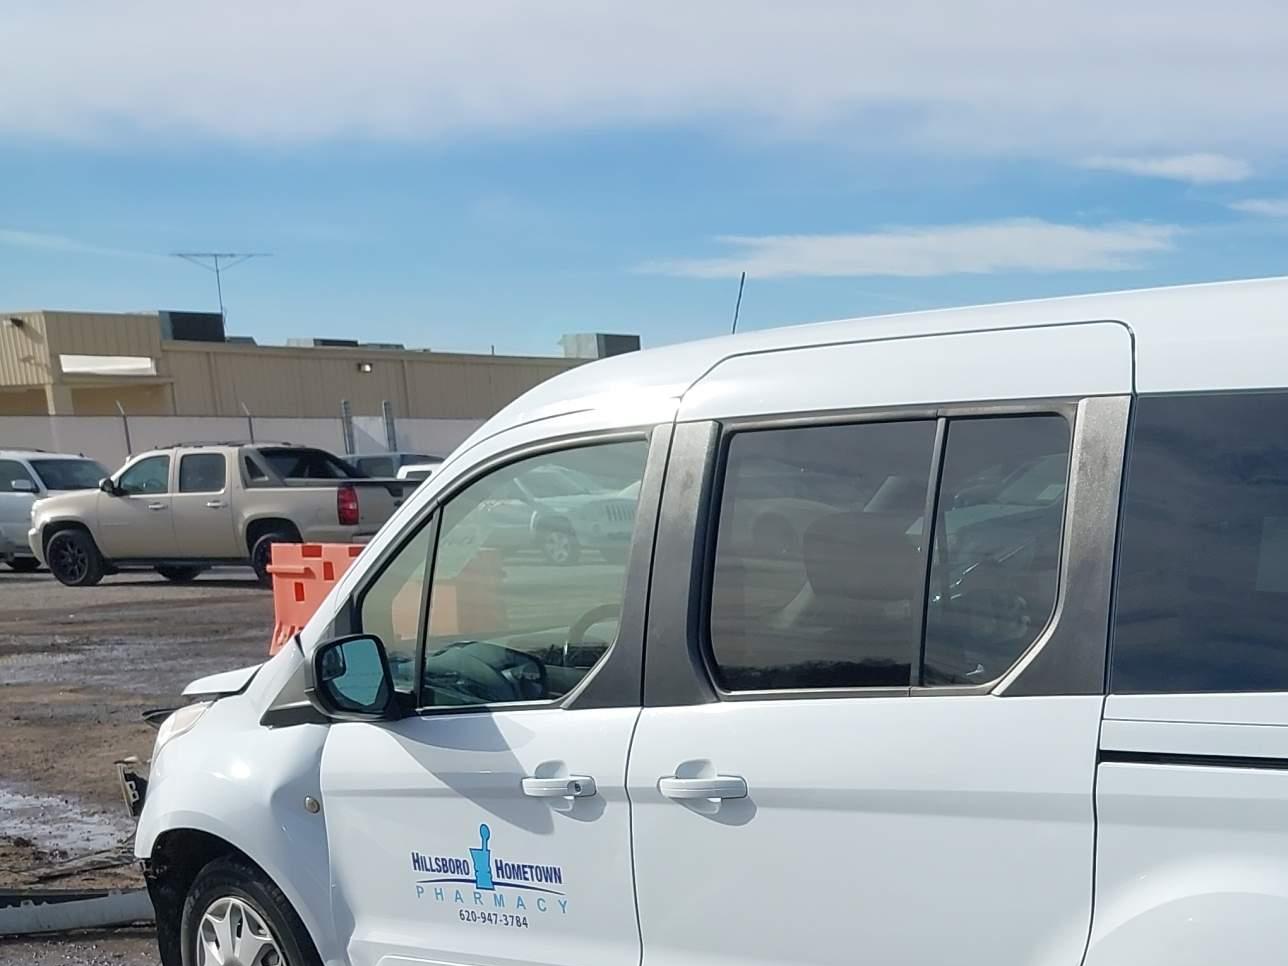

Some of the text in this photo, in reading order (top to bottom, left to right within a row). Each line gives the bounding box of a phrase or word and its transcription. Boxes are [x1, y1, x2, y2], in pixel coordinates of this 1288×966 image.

[411, 852, 563, 884] HILLSBORO HOMETOWN
[416, 885, 568, 914] PHARMACY
[459, 909, 529, 928] 620-947-3784
